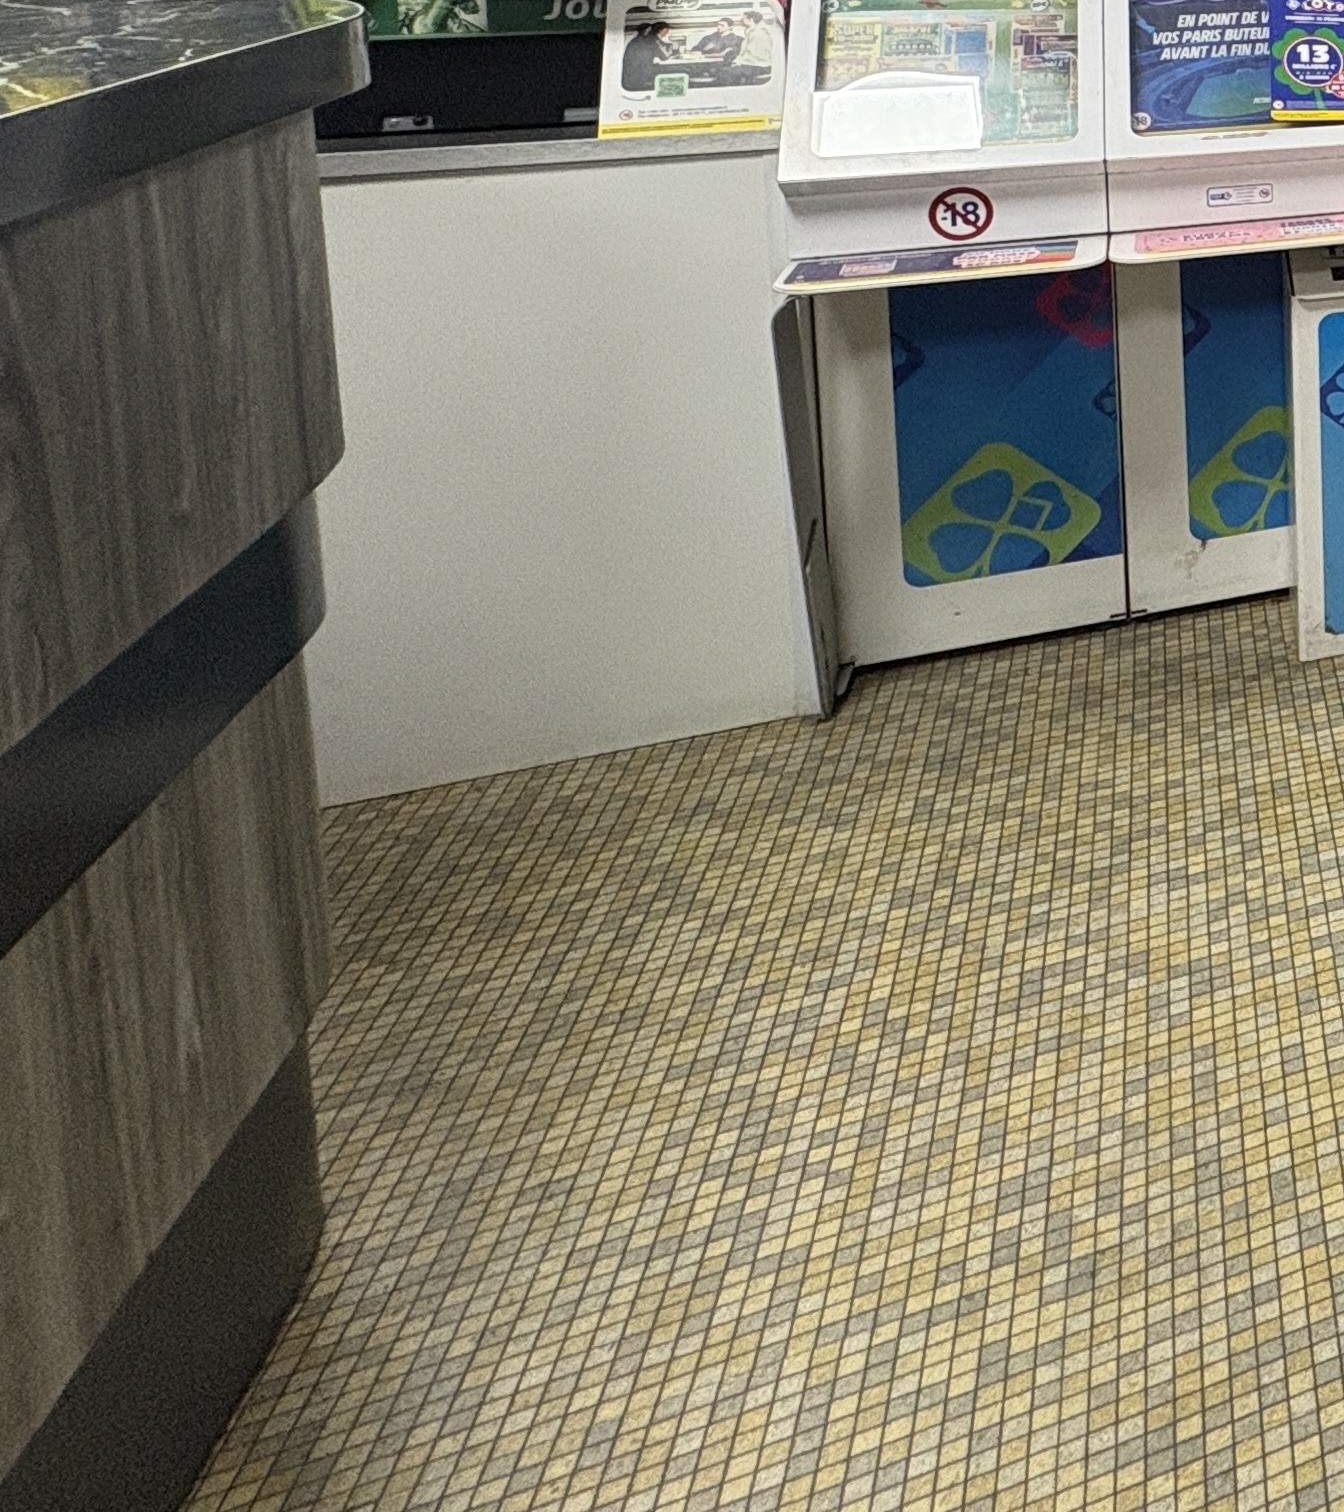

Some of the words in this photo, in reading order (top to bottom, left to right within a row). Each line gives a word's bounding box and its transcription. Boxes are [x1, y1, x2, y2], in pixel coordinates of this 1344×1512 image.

[1177, 15, 1194, 28] EN
[1198, 13, 1237, 27] POINT
[1241, 12, 1257, 24] DE
[1153, 31, 1180, 45] VOS
[1182, 29, 1221, 43] PARIS
[1160, 45, 1208, 61] AVANT
[1210, 45, 1228, 58] LA
[1231, 43, 1250, 56] FIN
[1297, 44, 1330, 63] 13
[941, 201, 980, 228] -18
